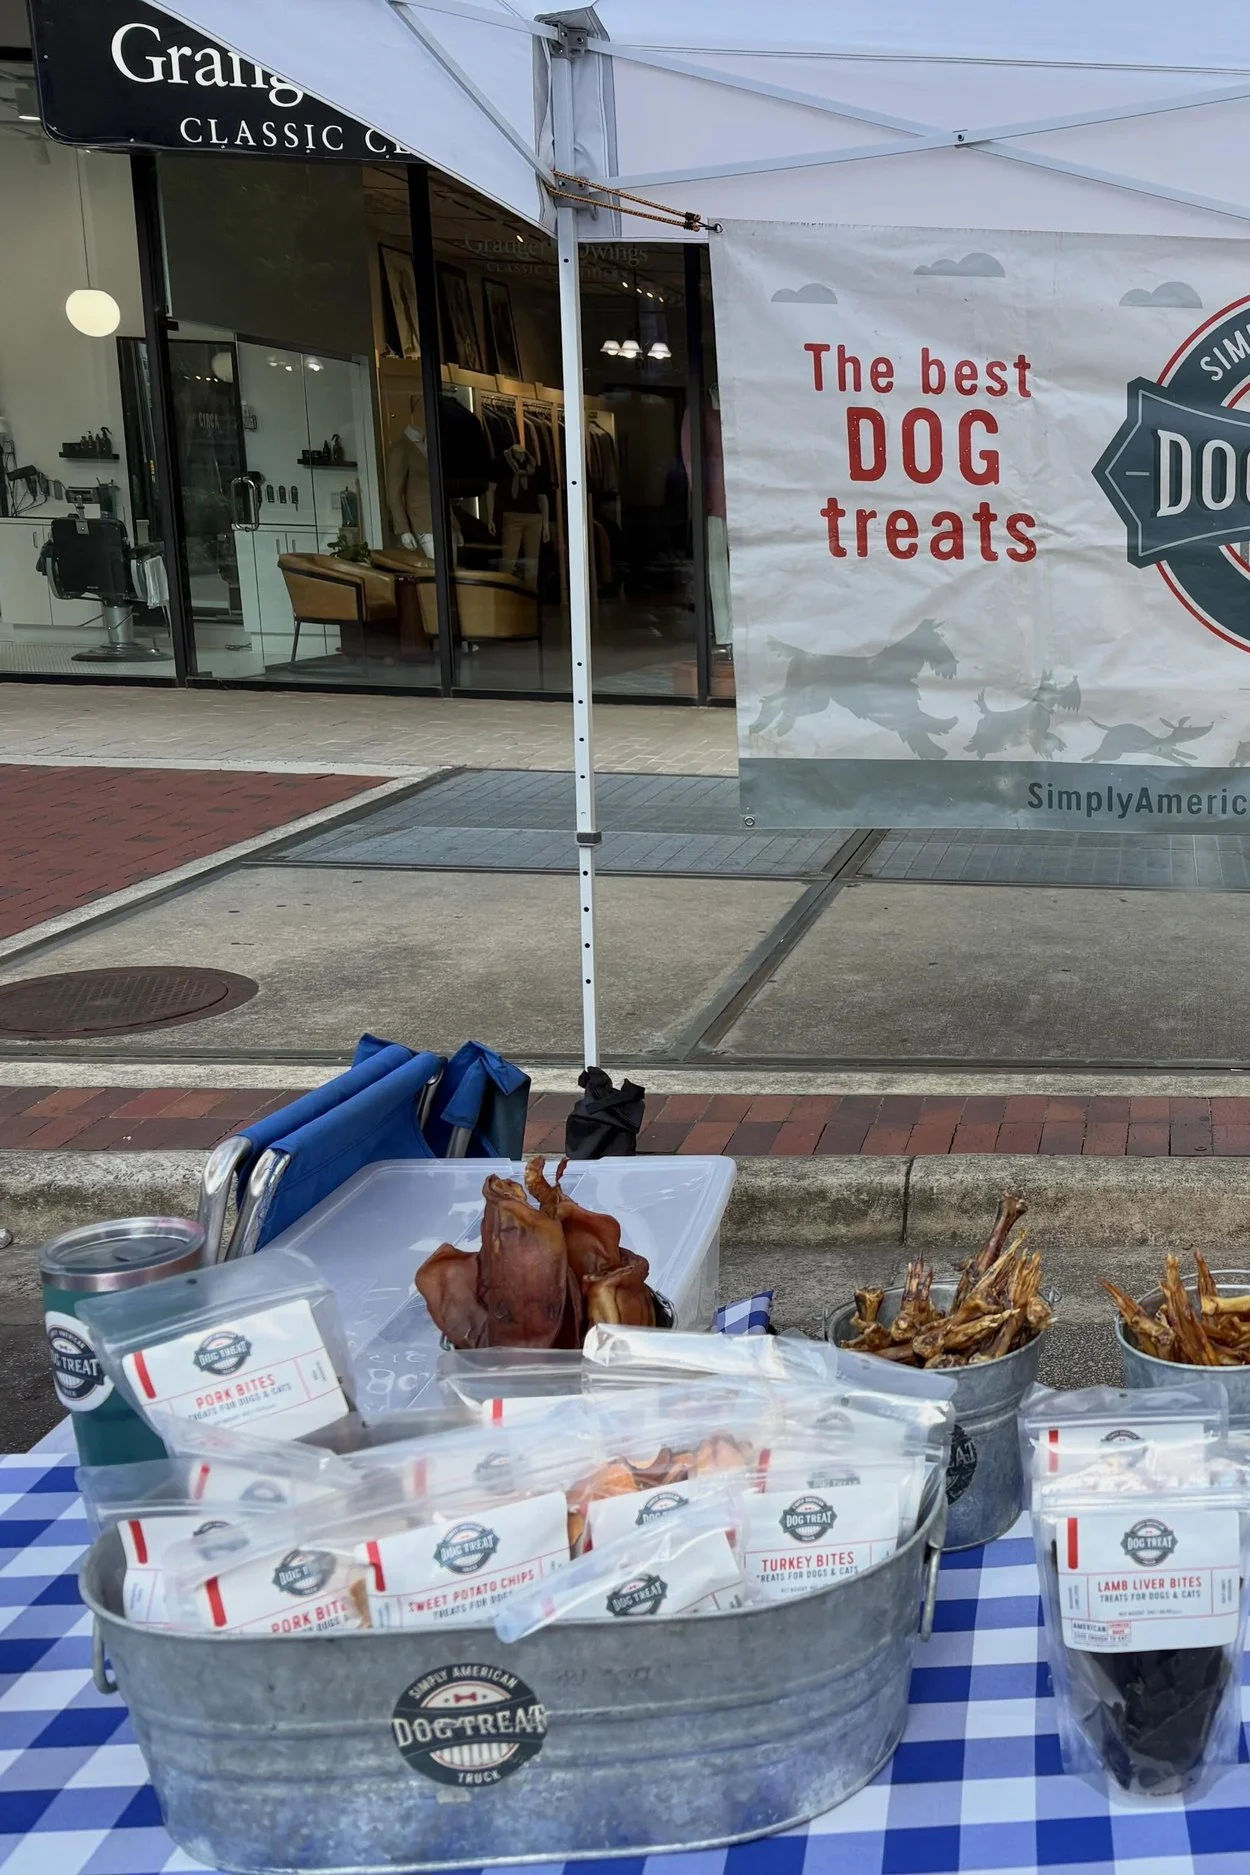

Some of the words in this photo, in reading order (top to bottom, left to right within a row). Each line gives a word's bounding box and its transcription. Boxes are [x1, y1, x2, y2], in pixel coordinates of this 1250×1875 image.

[111, 23, 304, 108] Grang
[180, 117, 344, 151] CLASSIC
[803, 342, 895, 394] The
[921, 347, 1032, 399] best
[846, 406, 1000, 487] DOG
[820, 497, 1038, 563] treats
[61, 1356, 98, 1376] TREAT
[195, 1387, 233, 1410] PORK
[235, 1373, 277, 1397] BITES
[785, 1513, 804, 1527] DOG
[805, 1510, 833, 1524] TREAT
[1127, 1537, 1145, 1550] DOG
[1146, 1536, 1173, 1549] TREAT
[762, 1555, 812, 1573] TURKEY
[816, 1551, 855, 1568] BITES
[788, 1570, 804, 1580] FOR
[806, 1568, 828, 1578] DOGS
[840, 1565, 859, 1575] CATS
[408, 1594, 448, 1613] SWEET
[453, 1581, 498, 1603] POTATO
[500, 1569, 535, 1589] CHIPS
[1097, 1580, 1128, 1593] LAMB
[1133, 1578, 1165, 1591] LIVER
[1170, 1576, 1202, 1589] BITES
[1100, 1593, 1128, 1603] TREATS
[1131, 1592, 1146, 1601] FOR
[1149, 1591, 1169, 1600] DOGS
[1181, 1589, 1201, 1599] CATS
[271, 1612, 311, 1634] PORK
[409, 1669, 449, 1699] SIMPLY
[452, 1665, 519, 1690] AMERICAN
[392, 1717, 452, 1747] DOG
[458, 1704, 548, 1736] TREAT
[457, 1769, 501, 1784] TRUCK
